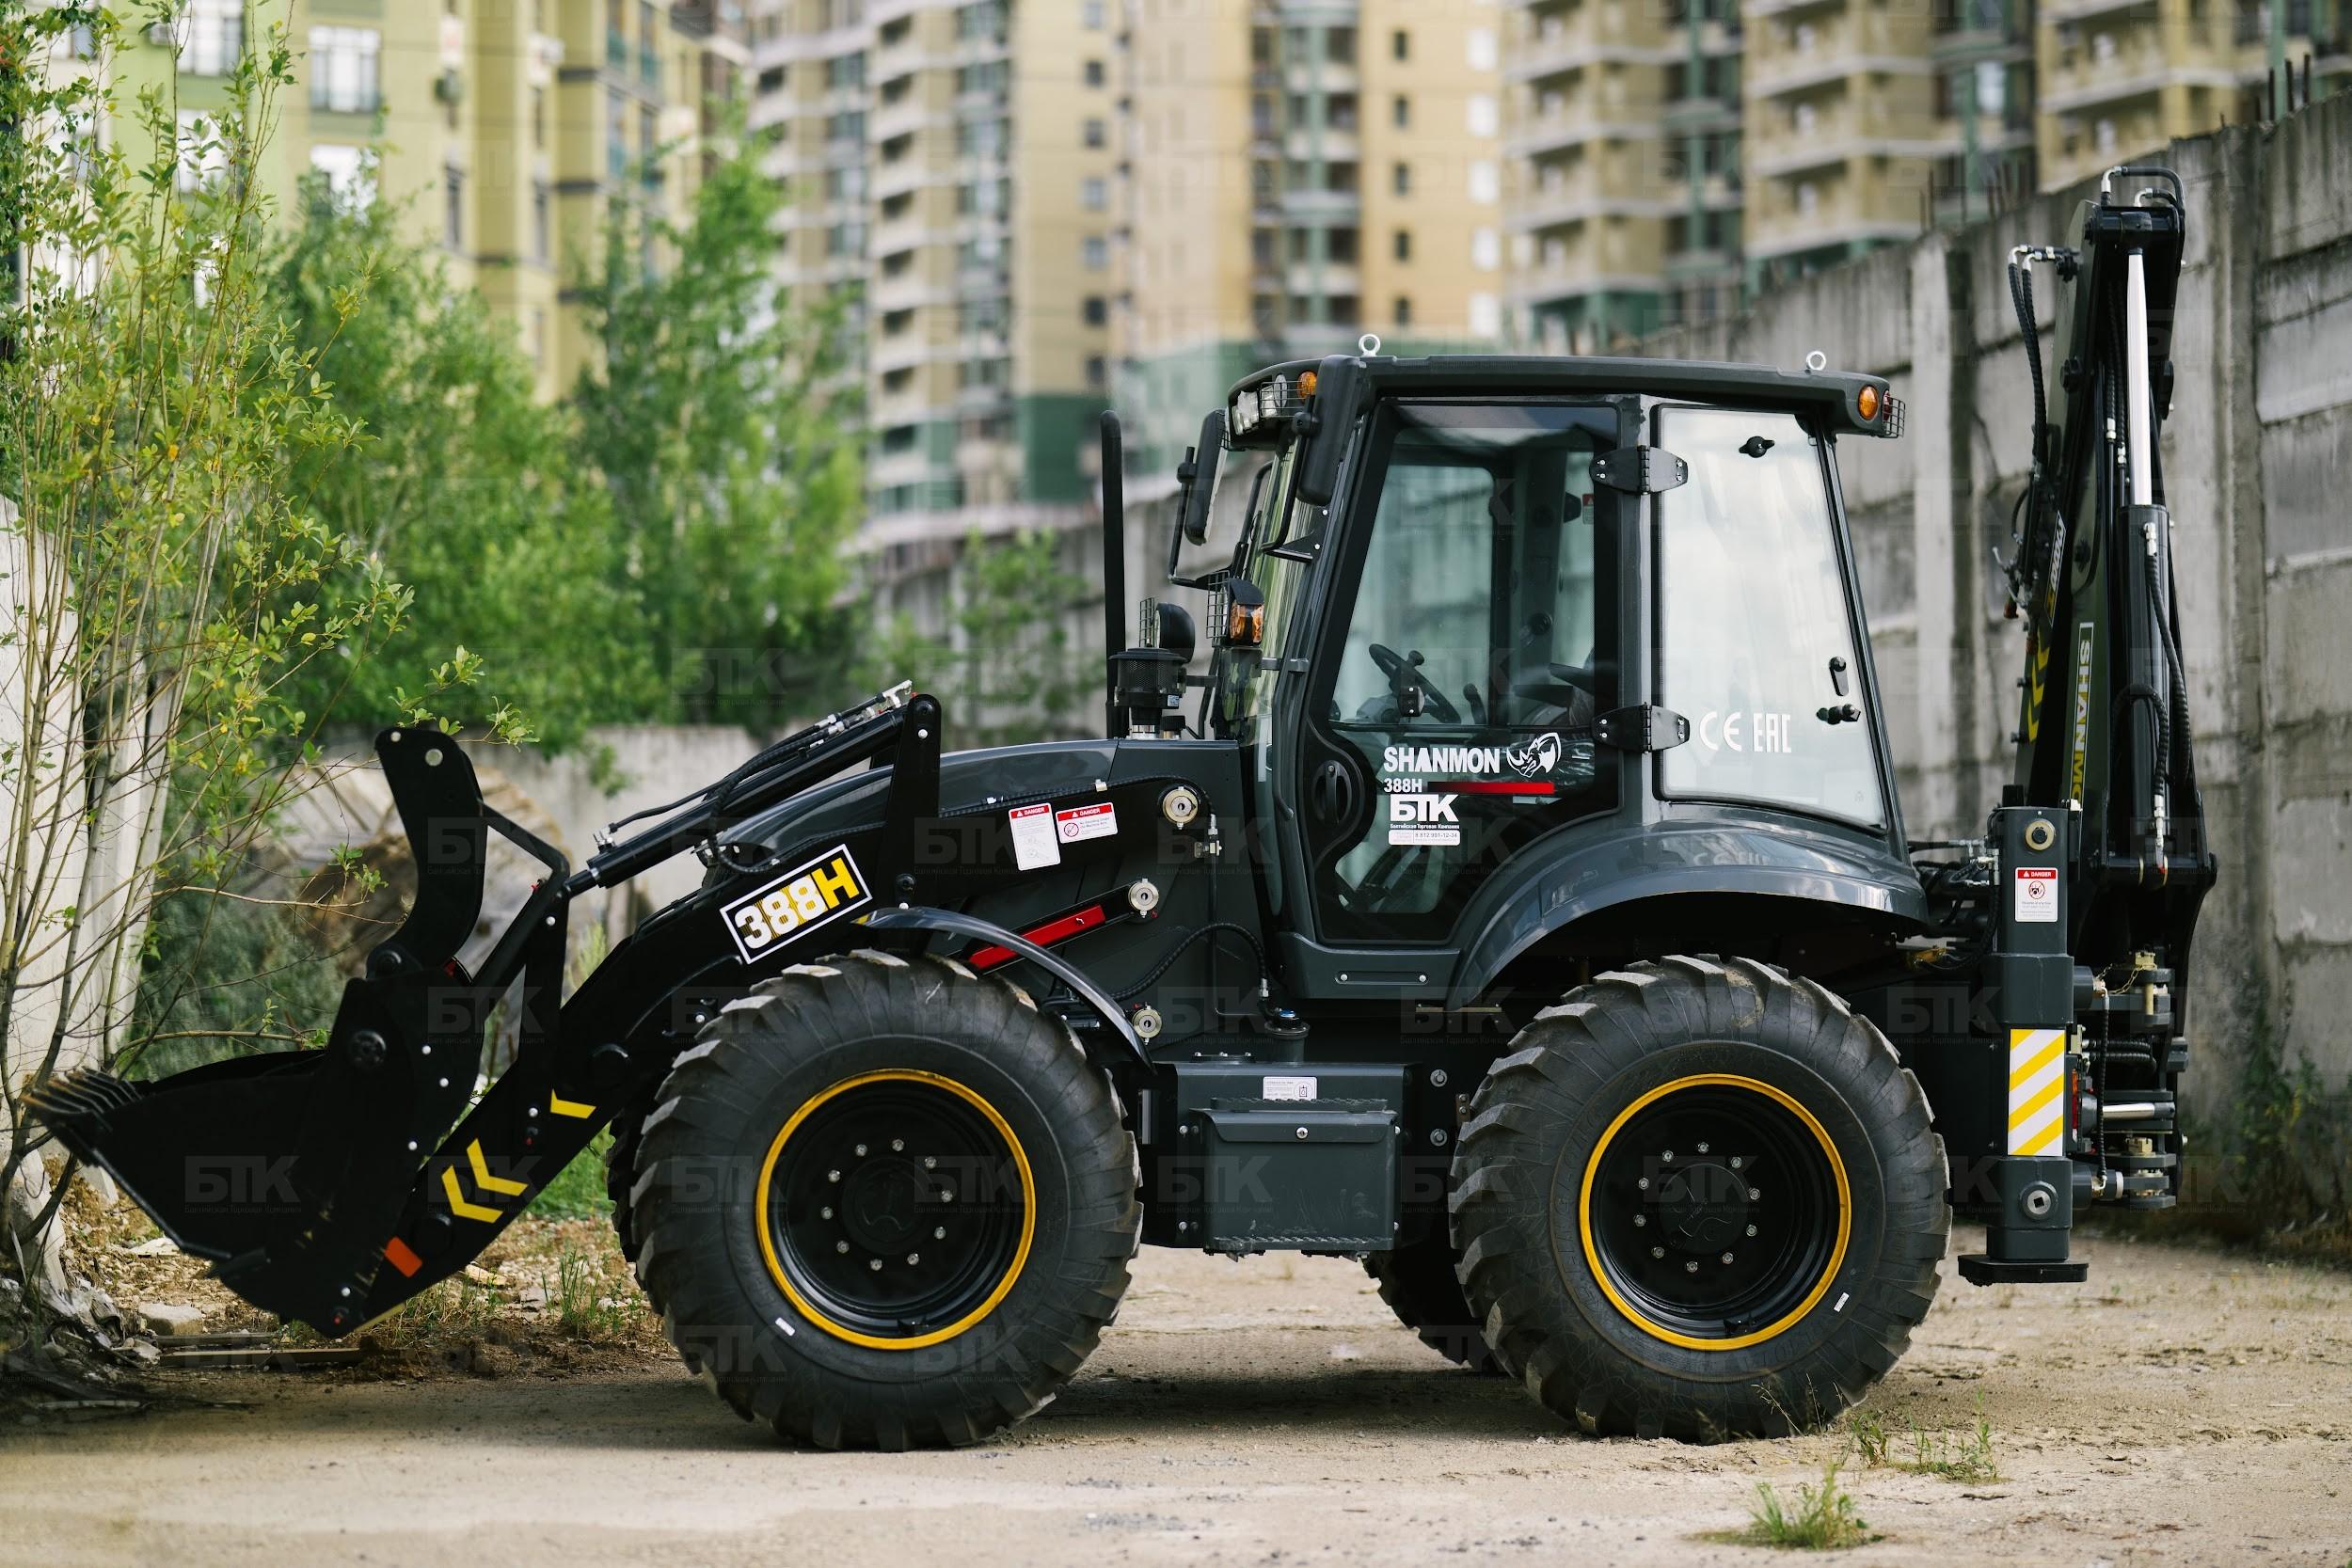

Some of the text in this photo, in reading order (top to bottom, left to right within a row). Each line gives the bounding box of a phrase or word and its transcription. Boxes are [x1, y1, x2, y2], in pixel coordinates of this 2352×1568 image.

[1699, 711, 1742, 752] CE
[1383, 747, 1501, 773] SHANMON
[1383, 778, 1422, 793] 388H
[1024, 807, 1045, 816] DANGER
[1079, 807, 1101, 816] DANGER
[1390, 794, 1459, 822] БТК
[734, 857, 860, 950] 388H
